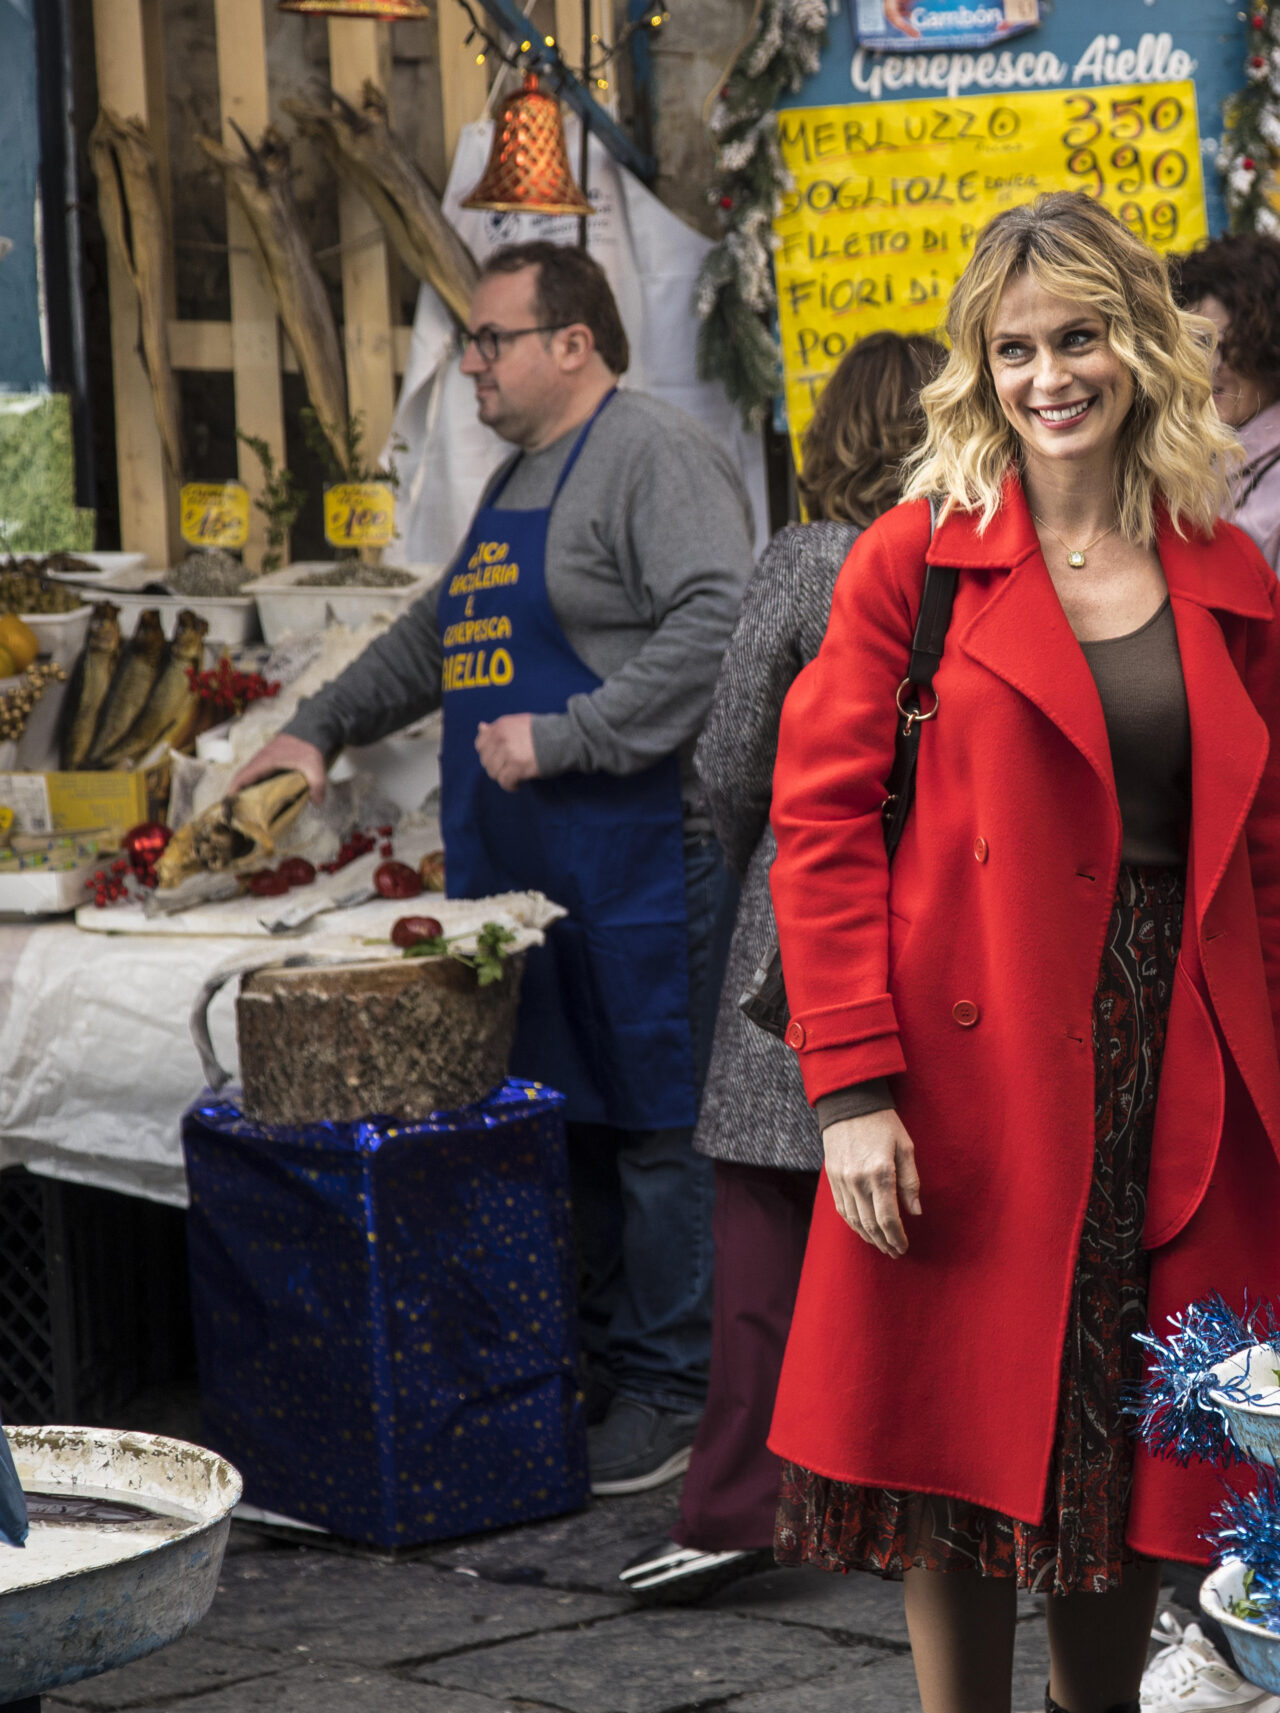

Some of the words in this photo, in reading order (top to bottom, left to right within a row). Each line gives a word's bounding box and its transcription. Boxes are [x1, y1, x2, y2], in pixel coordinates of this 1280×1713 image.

[850, 50, 1068, 100] Genepesca
[1071, 32, 1198, 85] Aiello
[1062, 95, 1184, 149] 350
